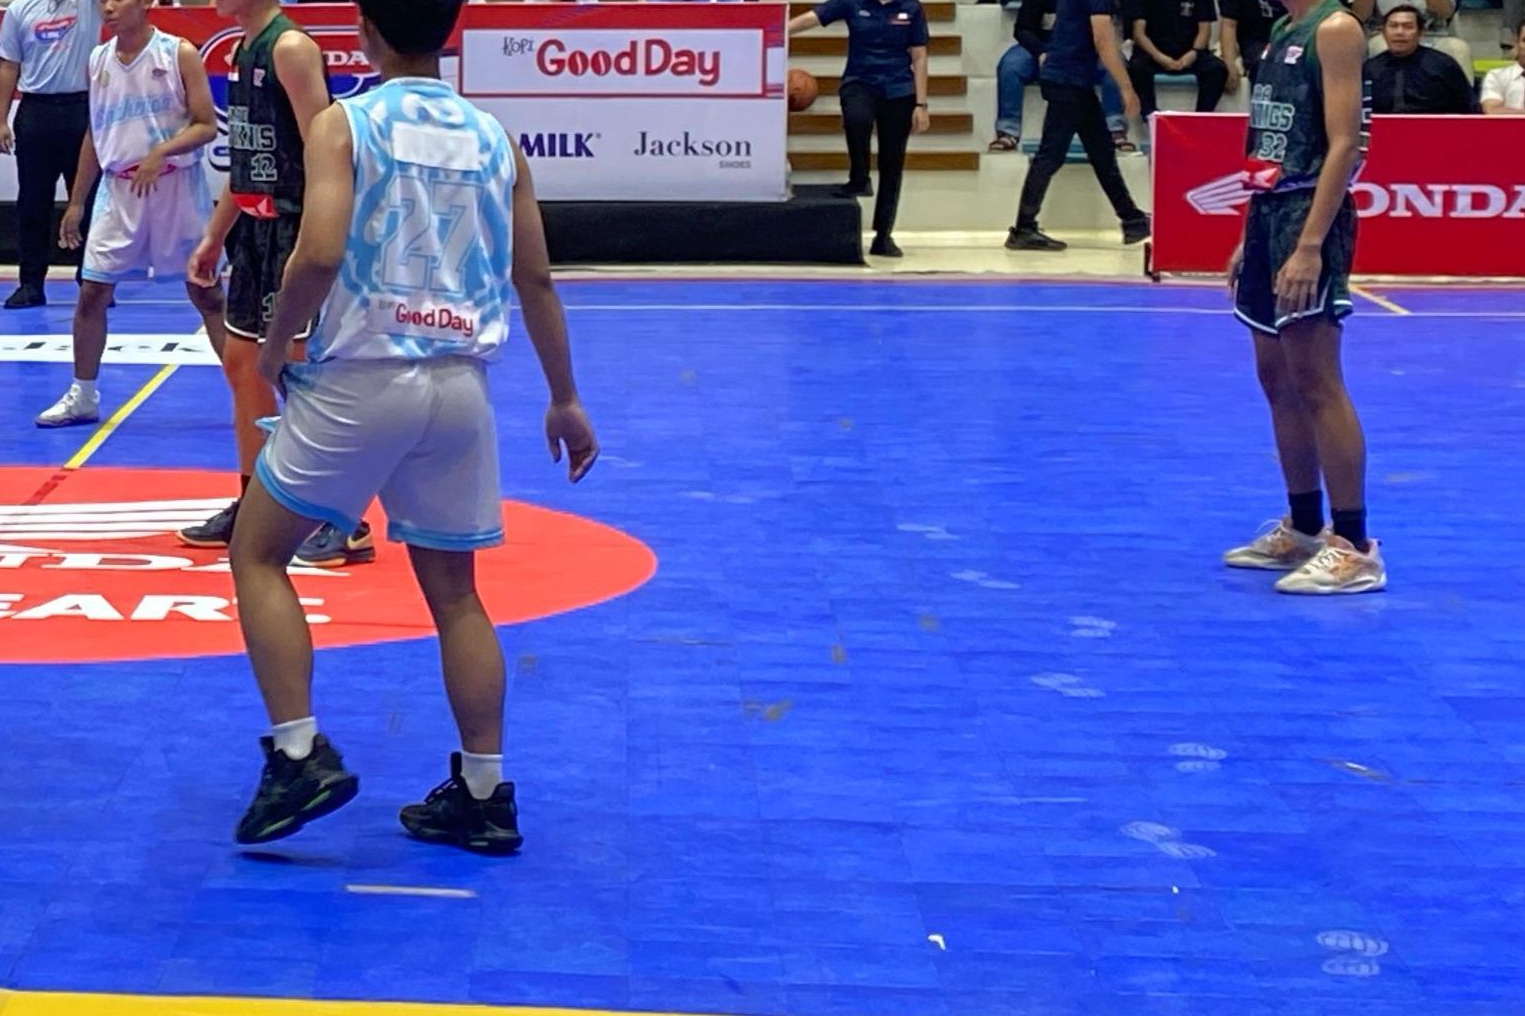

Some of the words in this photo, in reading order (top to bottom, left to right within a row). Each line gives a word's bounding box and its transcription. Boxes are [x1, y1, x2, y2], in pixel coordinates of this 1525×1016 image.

[536, 38, 637, 77] Good
[644, 38, 721, 86] Day
[633, 131, 752, 157] Jackson
[1257, 131, 1288, 163] 32
[250, 153, 278, 182] 12
[381, 174, 485, 297] 27
[438, 308, 474, 337] Day
